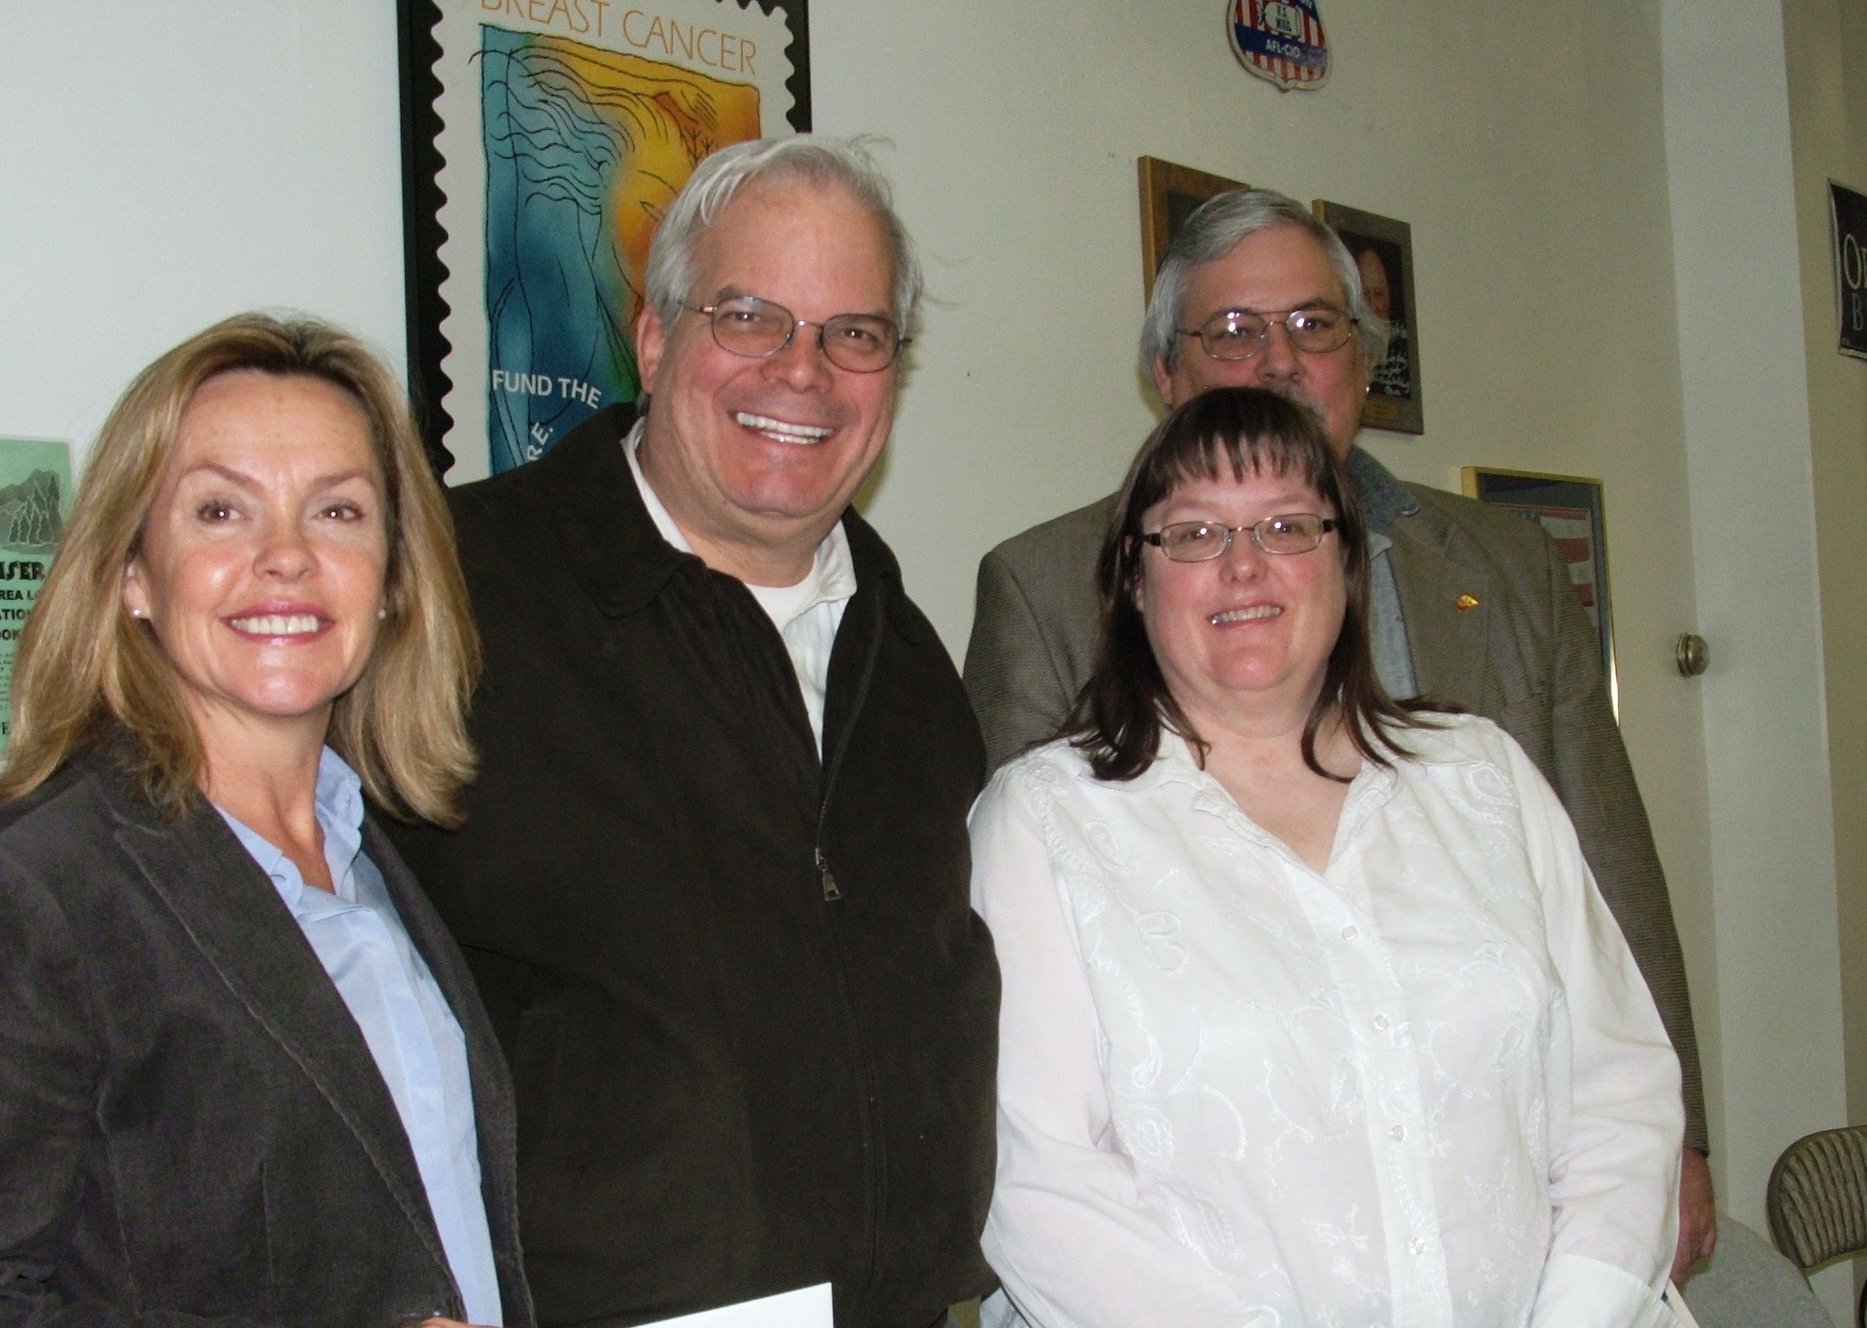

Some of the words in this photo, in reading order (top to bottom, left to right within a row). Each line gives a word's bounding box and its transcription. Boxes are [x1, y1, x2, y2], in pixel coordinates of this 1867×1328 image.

[481, 0, 609, 37] EAST
[623, 10, 757, 75] CANCER
[492, 370, 552, 396] FUND
[558, 377, 602, 409] THE
[0, 608, 32, 620] TIO
